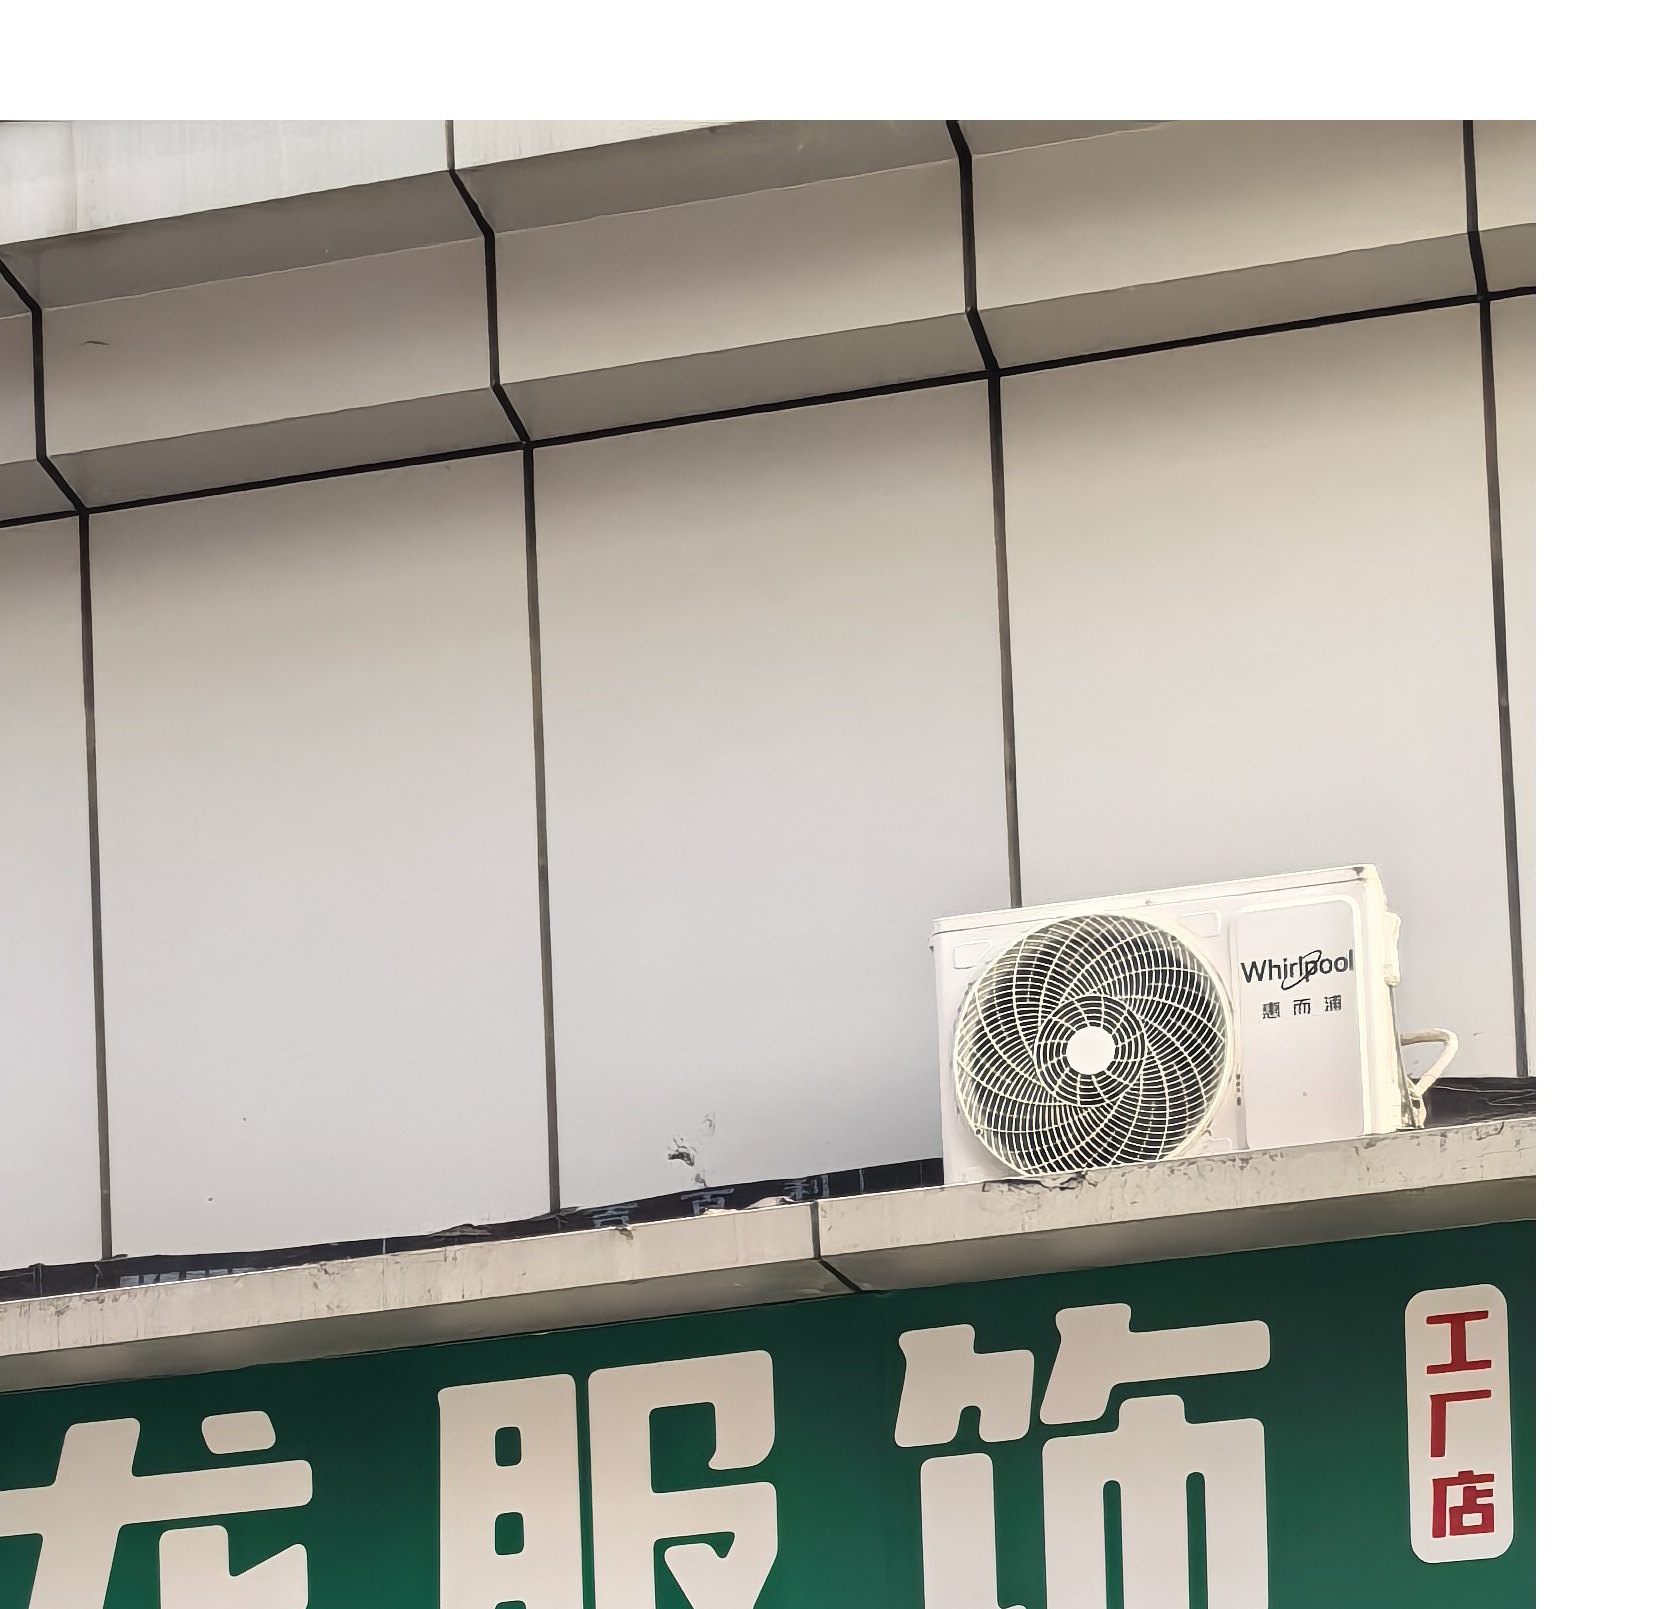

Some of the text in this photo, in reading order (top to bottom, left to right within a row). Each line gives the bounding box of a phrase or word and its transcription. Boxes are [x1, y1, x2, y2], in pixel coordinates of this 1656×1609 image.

[1240, 949, 1353, 988] Whirlpool
[1426, 1310, 1495, 1539] 工厂店
